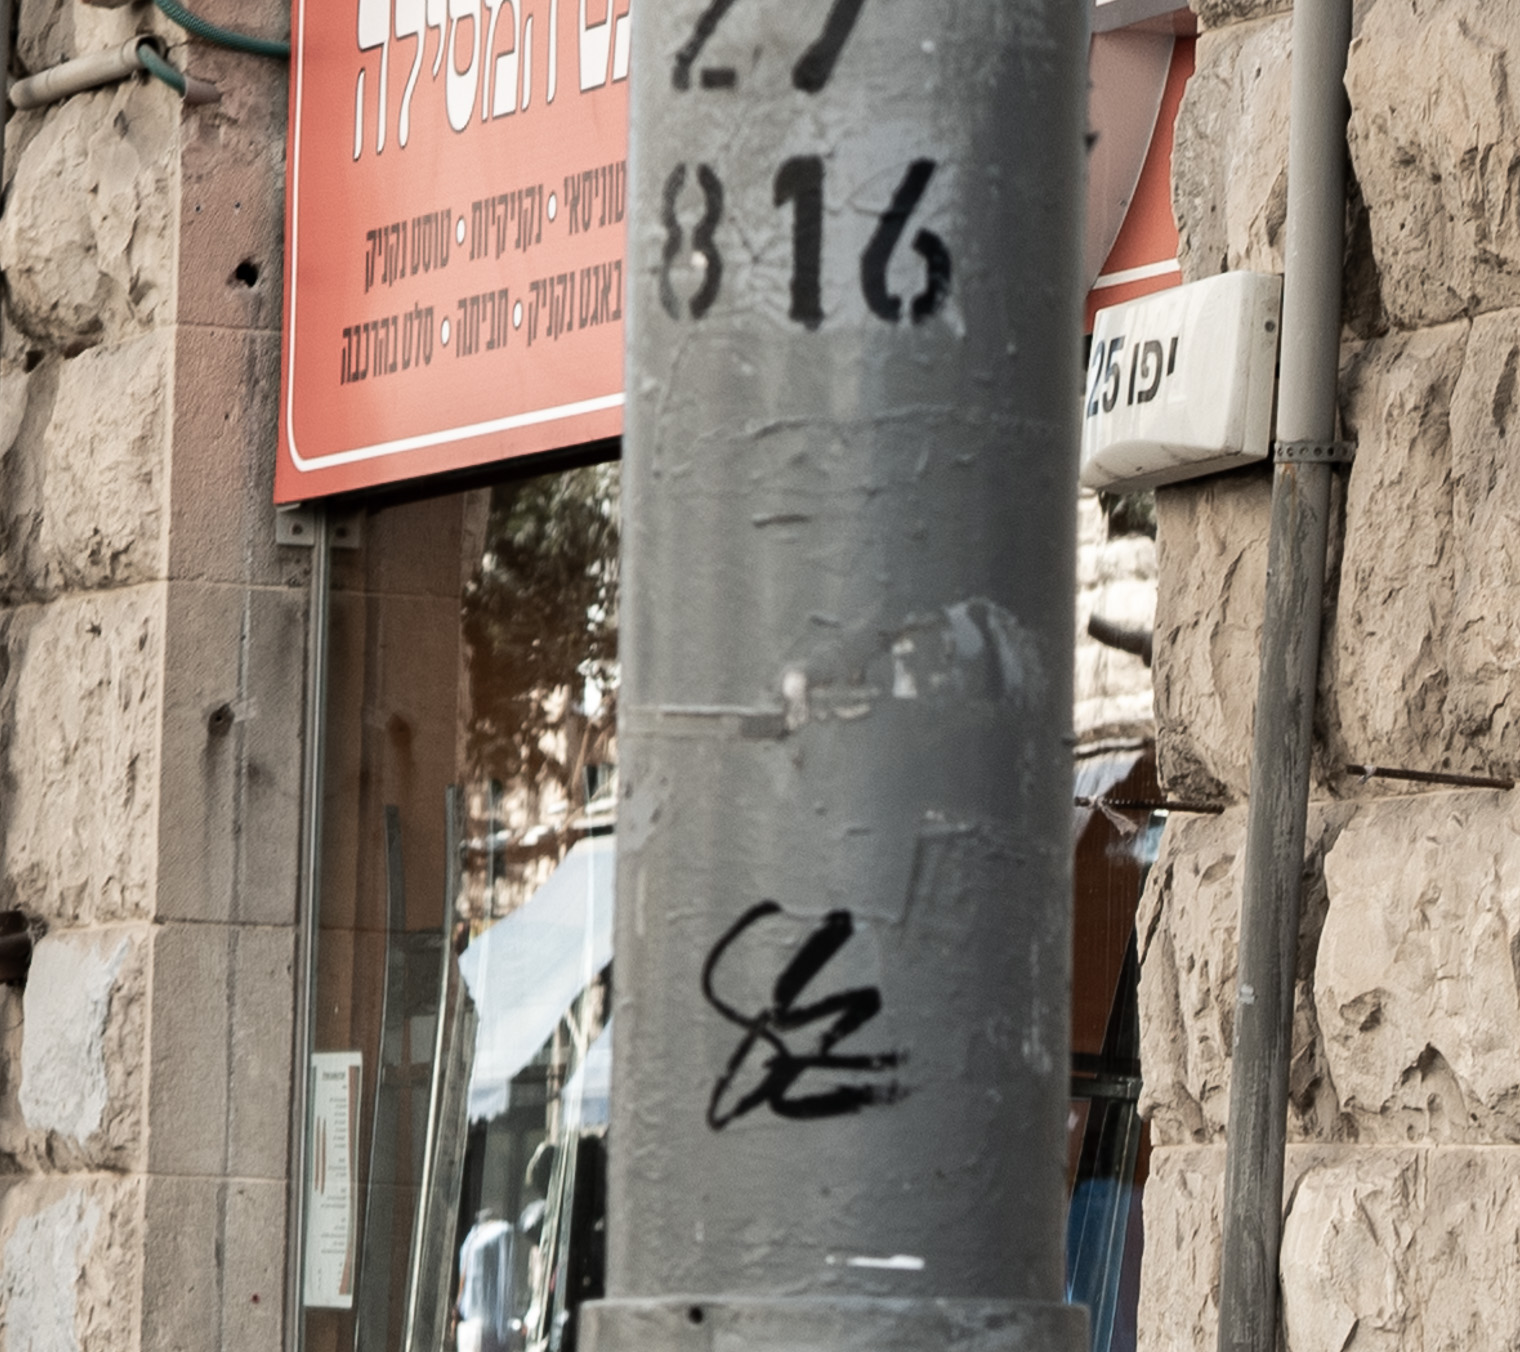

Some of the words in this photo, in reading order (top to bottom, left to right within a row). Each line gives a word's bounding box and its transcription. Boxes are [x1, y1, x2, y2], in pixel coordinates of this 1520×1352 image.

[409, 208, 451, 276] טוסט
[658, 154, 952, 329] 816
[578, 259, 622, 331] באגט
[401, 301, 434, 371] סלט
[1126, 336, 1178, 406] יפו
[1086, 335, 1125, 419] 25
